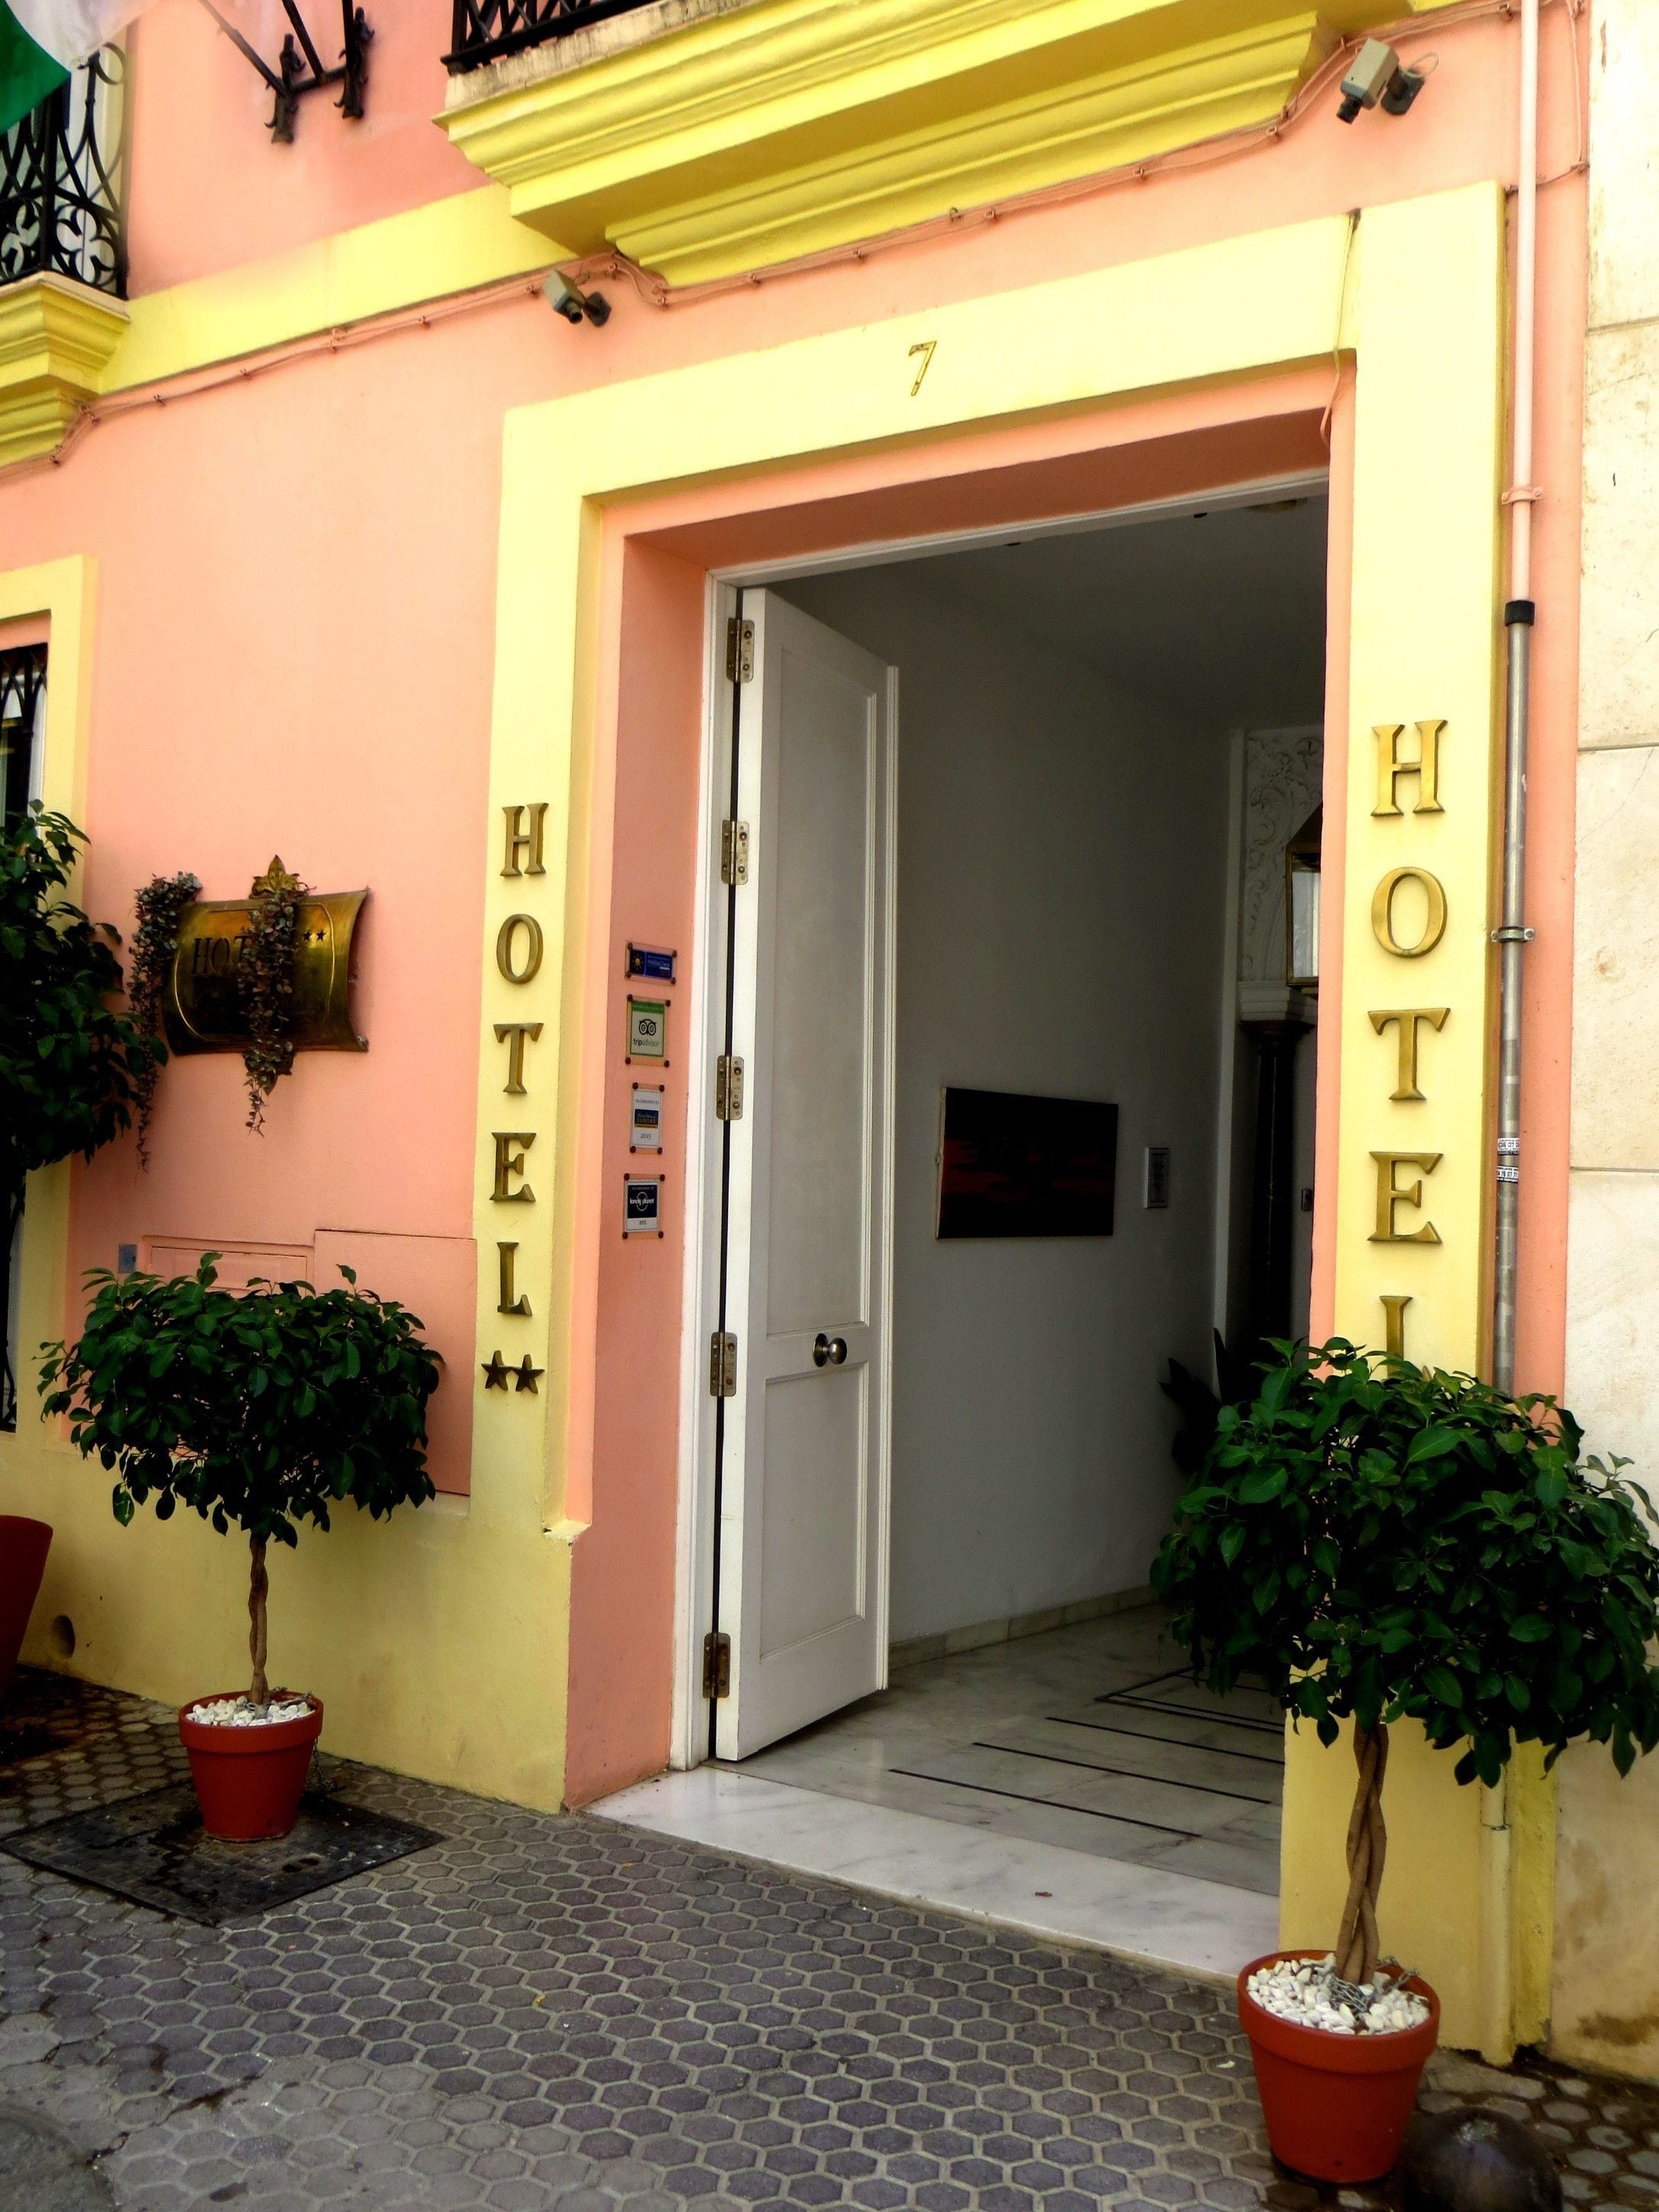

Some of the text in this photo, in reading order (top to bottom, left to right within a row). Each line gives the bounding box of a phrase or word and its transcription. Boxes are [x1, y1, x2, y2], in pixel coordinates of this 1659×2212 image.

[908, 340, 937, 396] 7
[490, 802, 549, 1316] HOTEL
[629, 1197, 655, 1206] lonely planet
